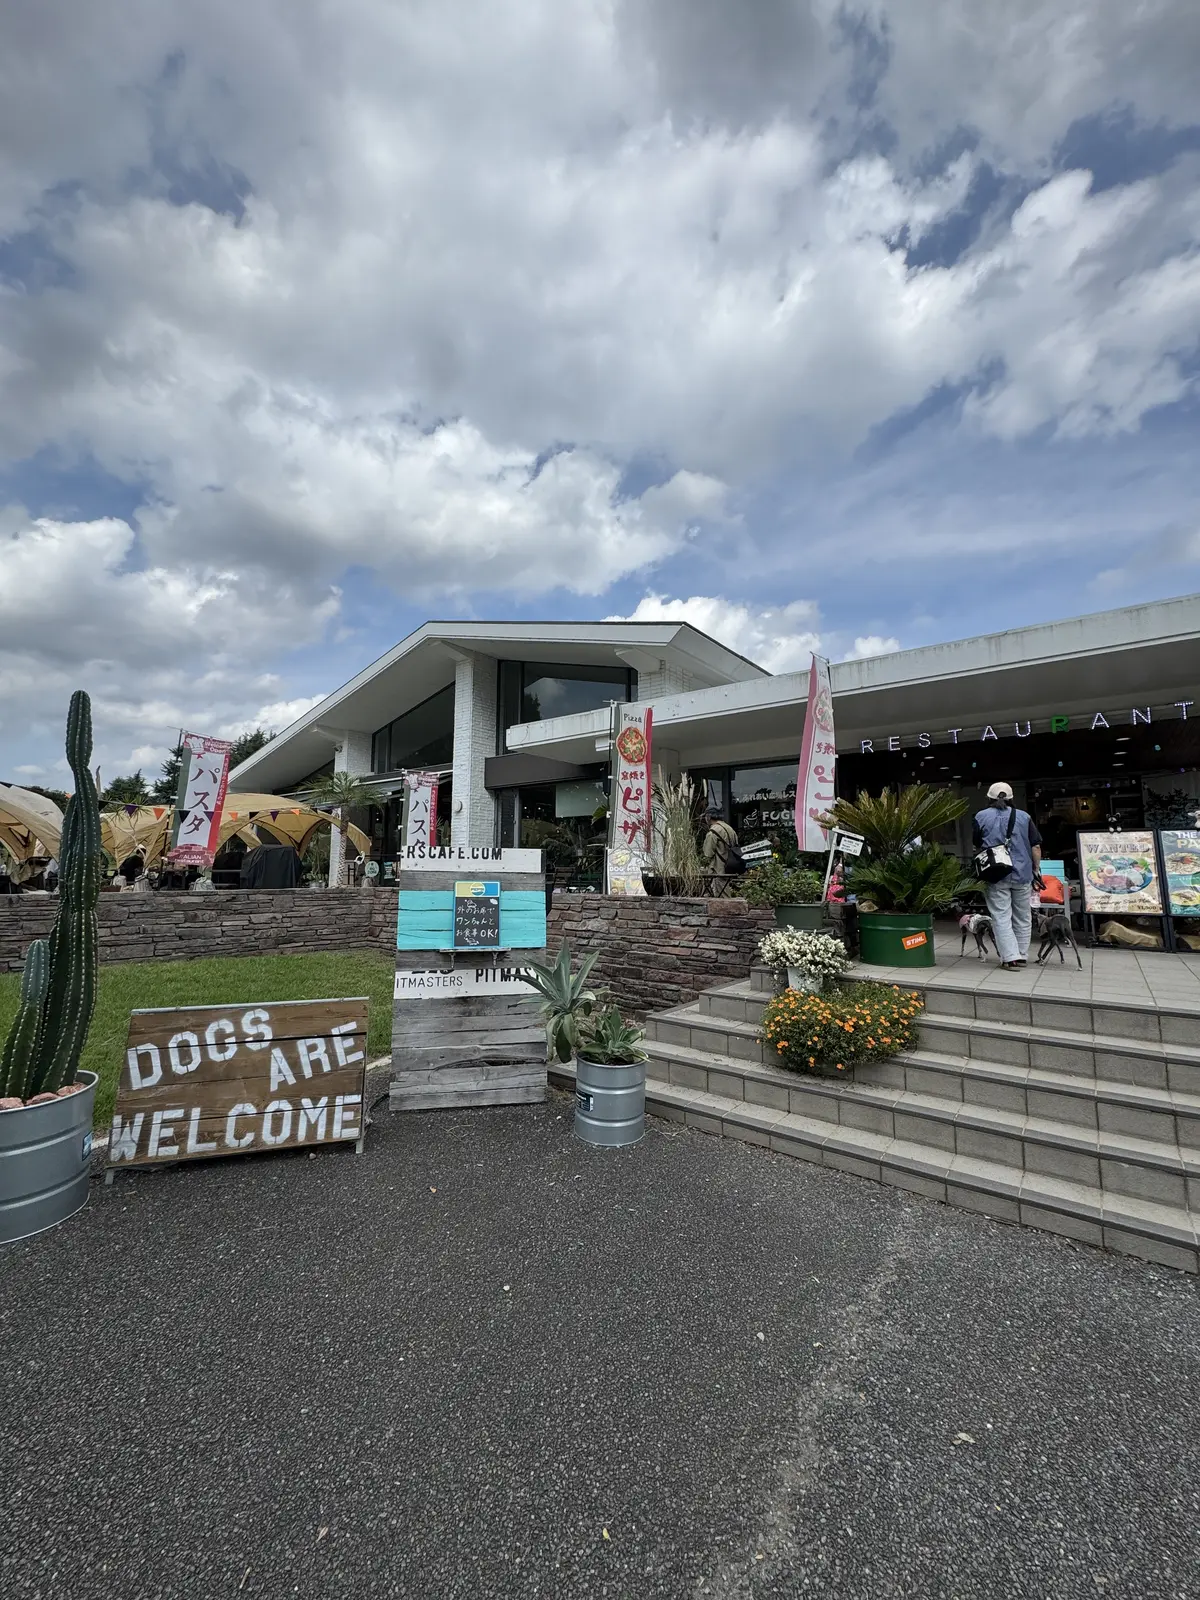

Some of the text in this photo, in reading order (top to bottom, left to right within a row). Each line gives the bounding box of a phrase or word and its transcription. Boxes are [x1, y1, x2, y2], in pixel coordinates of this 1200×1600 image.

[624, 713, 642, 723] Pizza
[861, 701, 1194, 754] RESTAURANT
[184, 767, 220, 835] パスタ
[618, 786, 645, 845] ピザ
[1086, 843, 1150, 854] WANTED
[1177, 840, 1200, 849] PA
[906, 935, 925, 946] STIHL
[127, 1008, 273, 1091] DOGS
[270, 1021, 365, 1093] ARE
[110, 1094, 362, 1162] WELCOME
